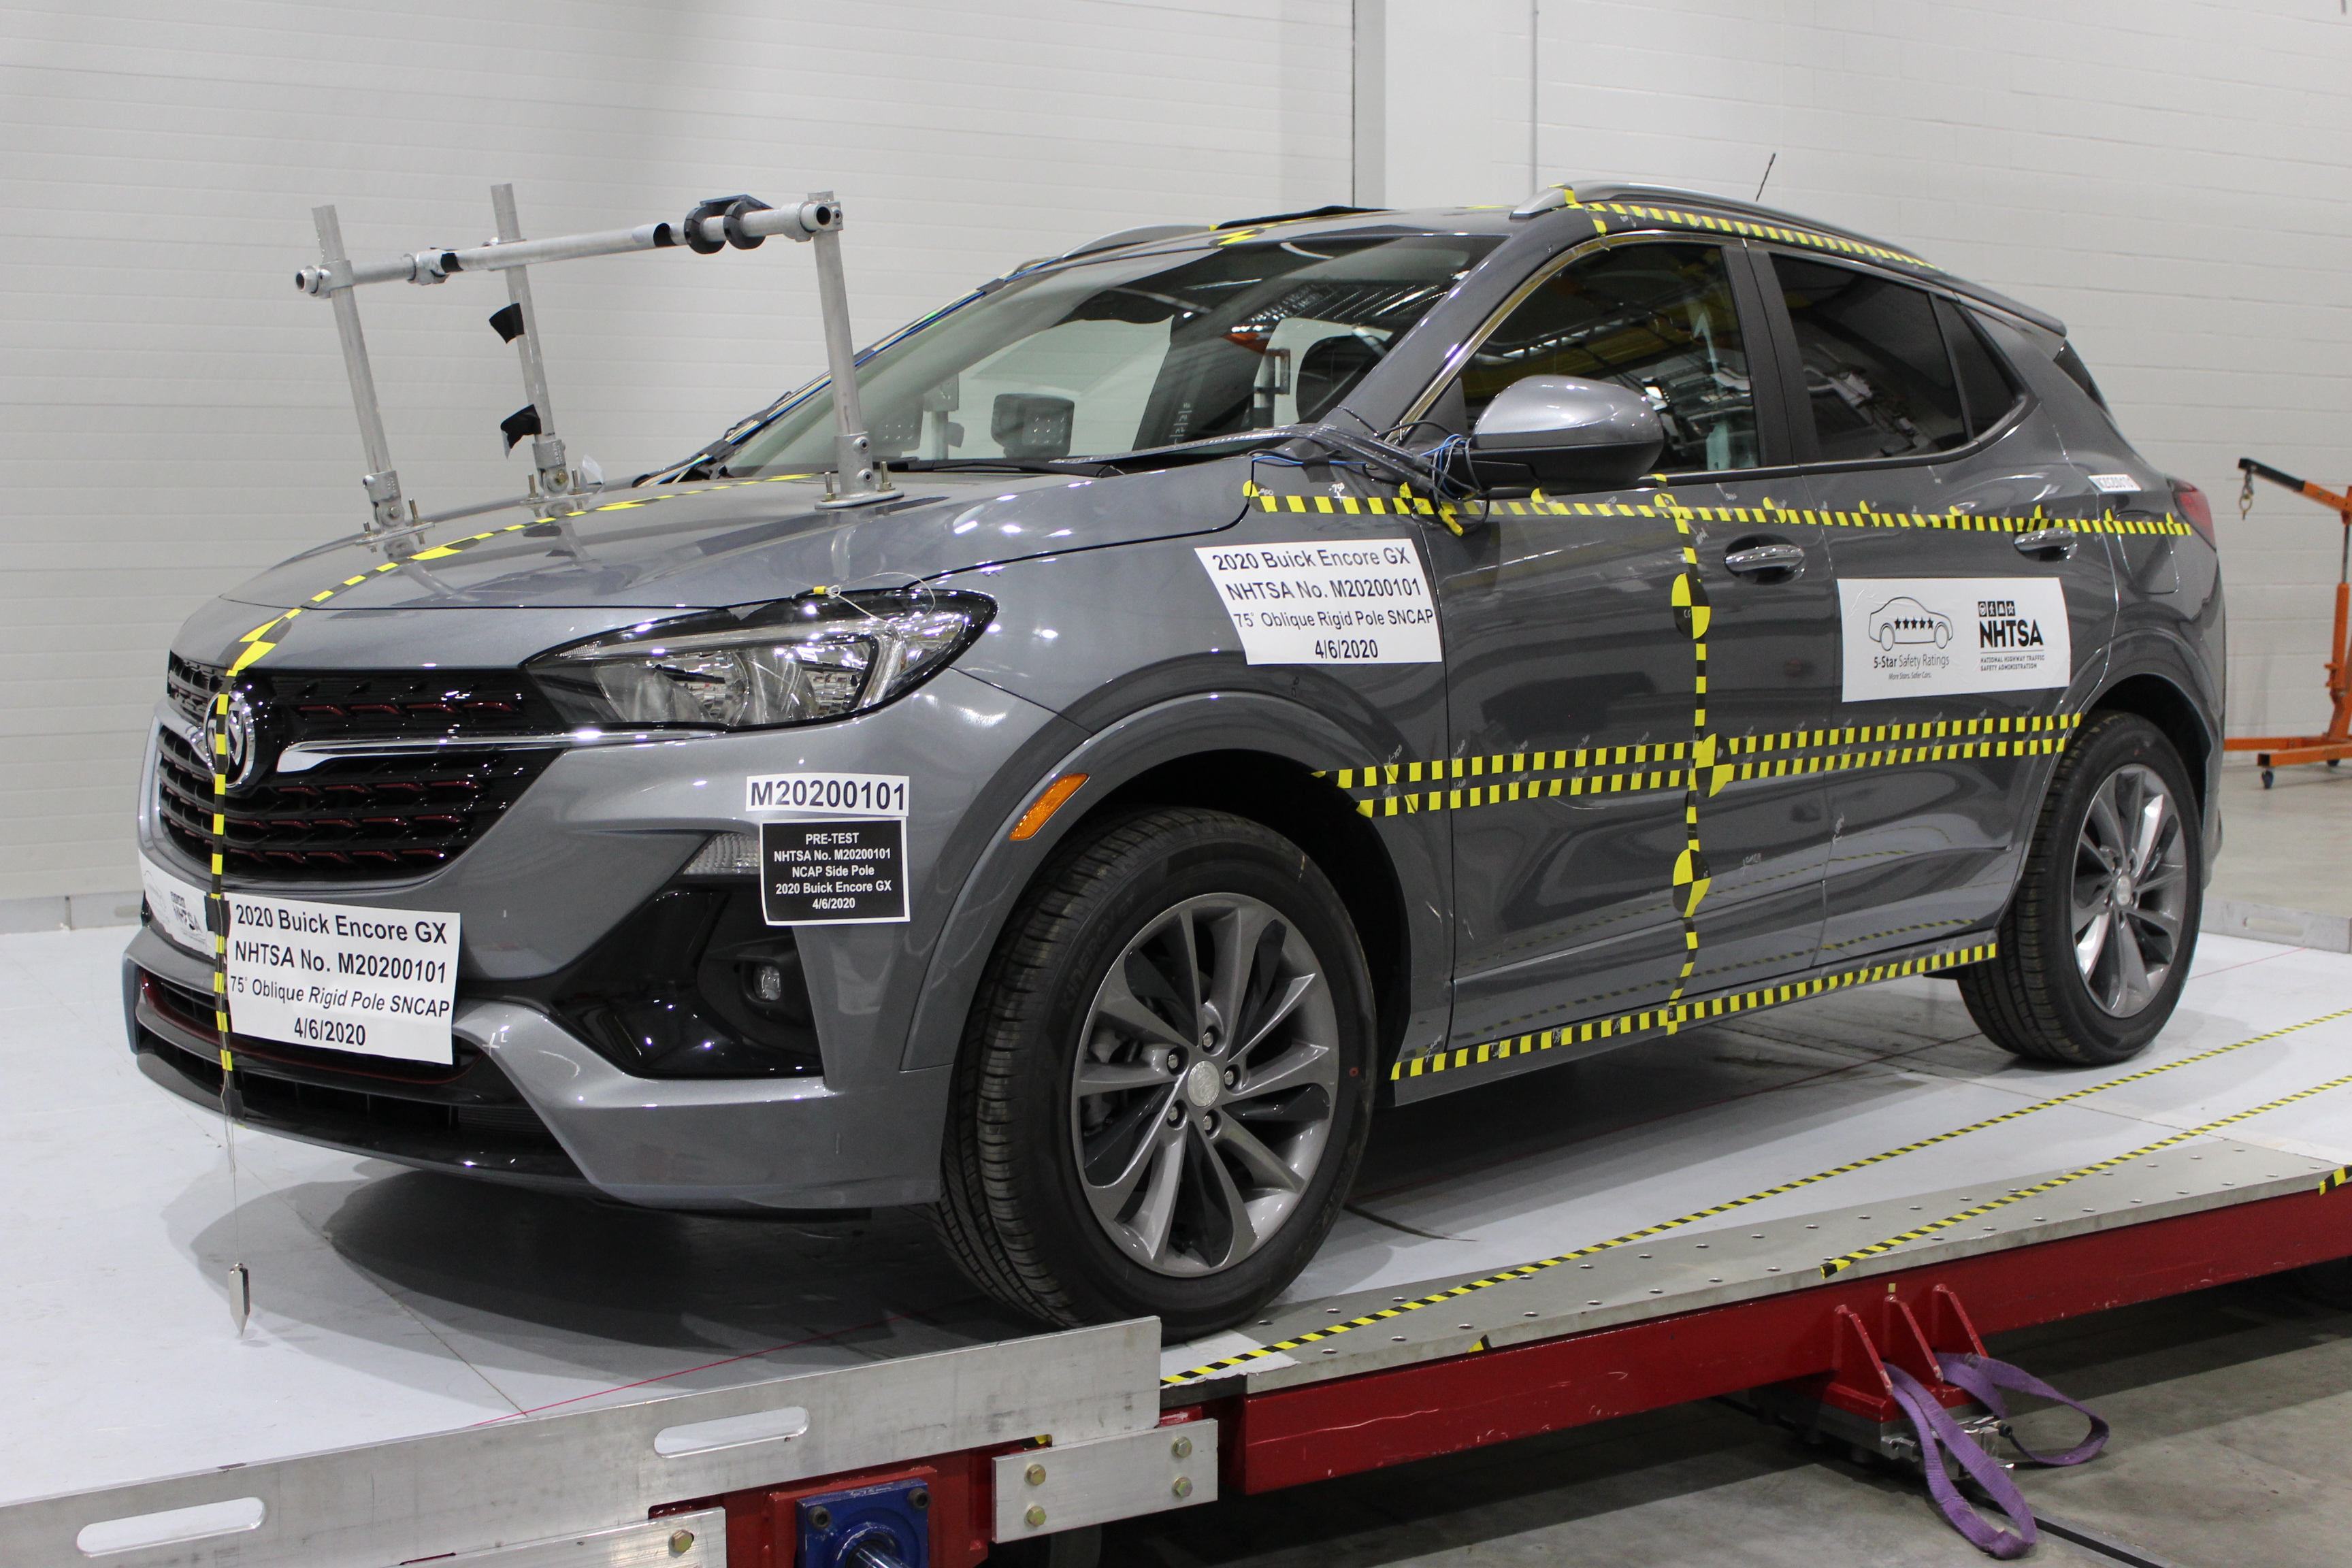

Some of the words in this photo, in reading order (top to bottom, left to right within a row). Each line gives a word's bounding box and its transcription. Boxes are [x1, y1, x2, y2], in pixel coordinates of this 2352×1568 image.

[1213, 553, 1259, 571] 2020
[1260, 550, 1316, 568] Buick
[1317, 549, 1380, 567] Encore
[1383, 547, 1411, 564] GX
[1225, 581, 1295, 601] NHTSA
[1296, 581, 1328, 599] No.
[1329, 578, 1421, 598] M20200101
[1261, 611, 1316, 630] Oblique
[1317, 611, 1353, 630] Rigid
[1356, 610, 1385, 626] Pole
[1387, 608, 1434, 625] SNCAP
[1979, 619, 2044, 649] NHTSA
[1315, 639, 1378, 659] 4/6/2020
[1874, 655, 1897, 669] 5-Star
[1899, 655, 1921, 670] Safety
[1923, 654, 1950, 669] Ratings
[751, 780, 904, 810] M20200101
[805, 832, 860, 845] PRE-TEST
[774, 851, 812, 862] NHTSA
[814, 850, 831, 861] No.
[834, 848, 891, 861] M20200101
[792, 866, 823, 878] NCAP
[825, 865, 849, 877] Side
[851, 864, 875, 876] Pole
[775, 883, 800, 895] 2020
[803, 882, 833, 894] Buick
[836, 881, 873, 893] Encore
[875, 880, 892, 892] GX
[812, 897, 855, 909] 4/6/2020
[236, 904, 273, 928] 2020
[278, 909, 330, 934] Buick
[335, 915, 408, 941] Encore
[414, 921, 447, 945] GX
[235, 941, 295, 968] NHTSA
[300, 949, 331, 973] No.
[338, 952, 446, 984] M20200101
[252, 979, 304, 1004] Oblique
[308, 986, 347, 1010] Rigid
[351, 990, 385, 1011] Pole
[389, 995, 451, 1018] SNCAP
[294, 1017, 367, 1046] 4/6/2020
